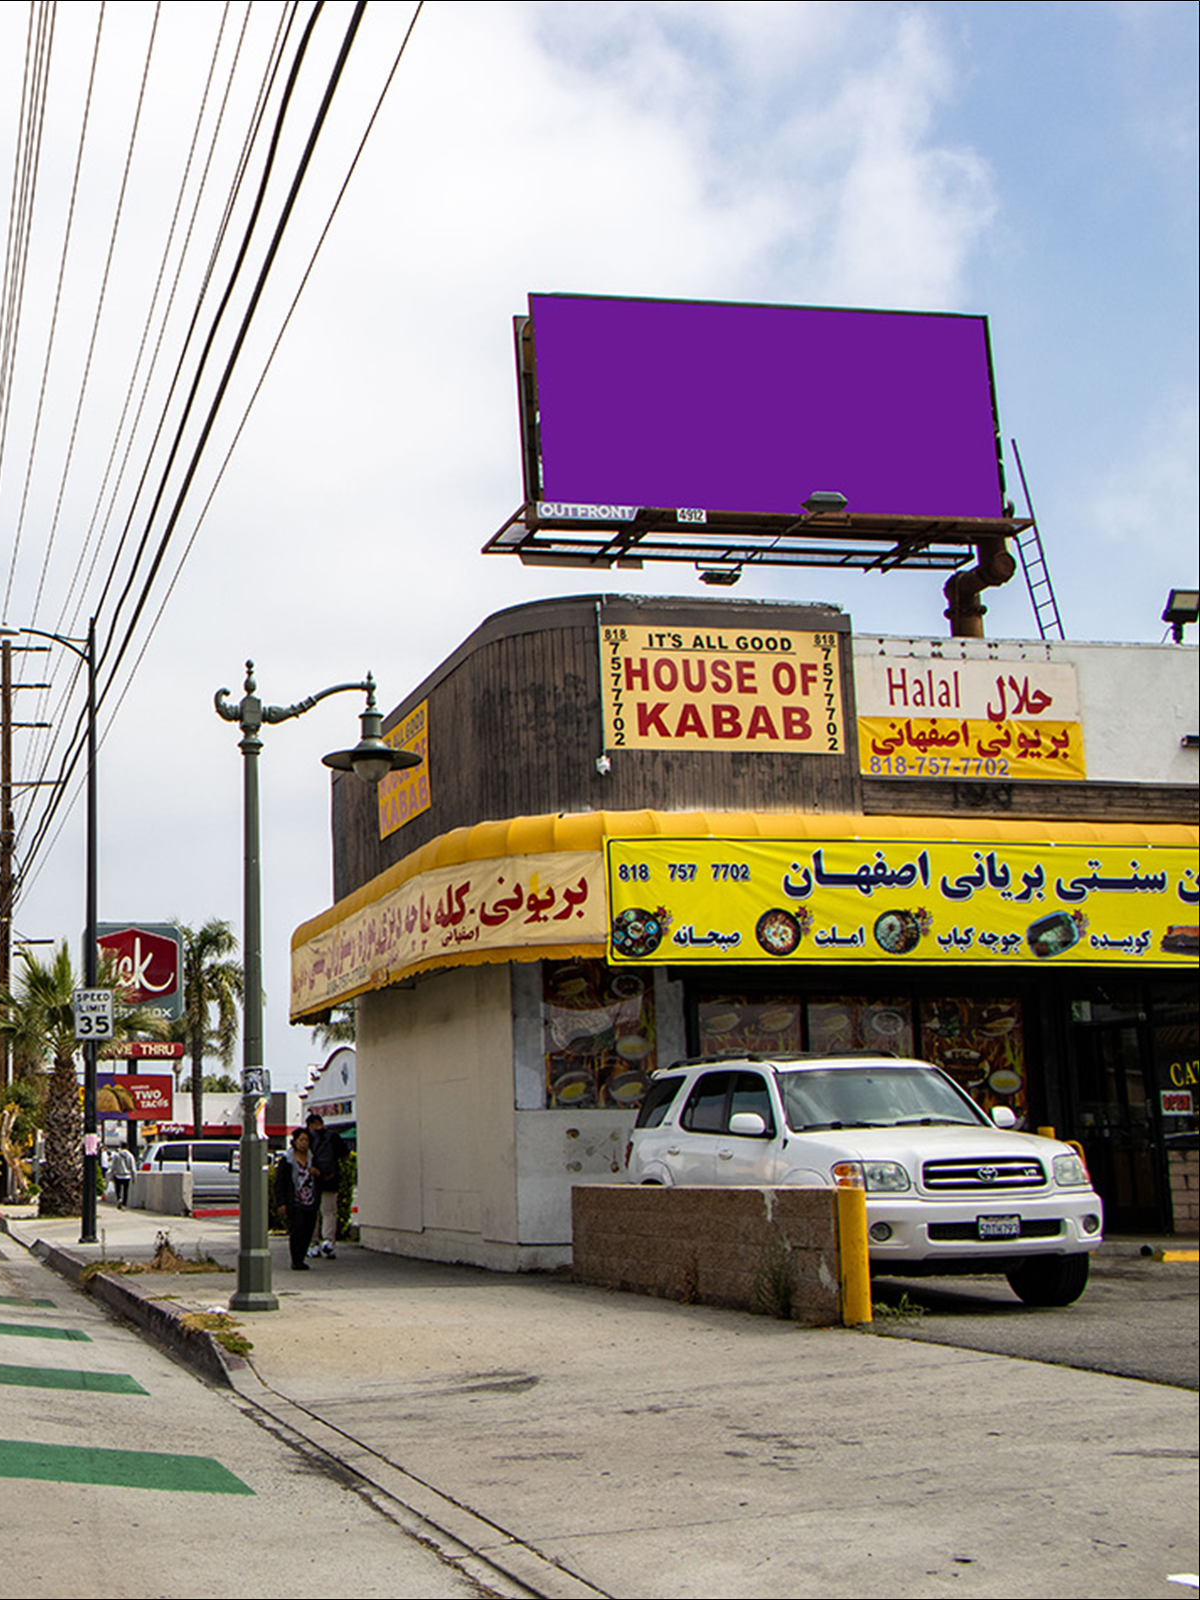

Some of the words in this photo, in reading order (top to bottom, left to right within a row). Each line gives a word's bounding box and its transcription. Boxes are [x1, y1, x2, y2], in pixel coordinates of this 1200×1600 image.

[540, 503, 634, 519] OUTFRONT
[678, 509, 704, 521] 4912
[604, 628, 627, 640] 818
[648, 633, 683, 648] IT'S
[692, 635, 729, 649] ALL
[736, 636, 792, 651] GOOD
[813, 634, 836, 646] 818
[624, 657, 758, 694] HOUSE
[772, 661, 818, 696] OF
[887, 667, 960, 708] Halal
[986, 675, 1053, 722] حلال
[636, 702, 813, 741] KABAB
[869, 755, 1010, 776] 818-757-7702
[380, 775, 429, 834] KABAB
[617, 863, 650, 882] 818
[667, 863, 699, 882] 757
[710, 863, 751, 882] 7702
[782, 848, 931, 899] اصفهان
[940, 850, 1046, 903] بریانی
[76, 993, 110, 1001] SPEED
[79, 1004, 107, 1013] LIMIT
[79, 1016, 110, 1035] 35
[140, 1043, 175, 1056] THRU
[134, 1089, 162, 1101] TWO
